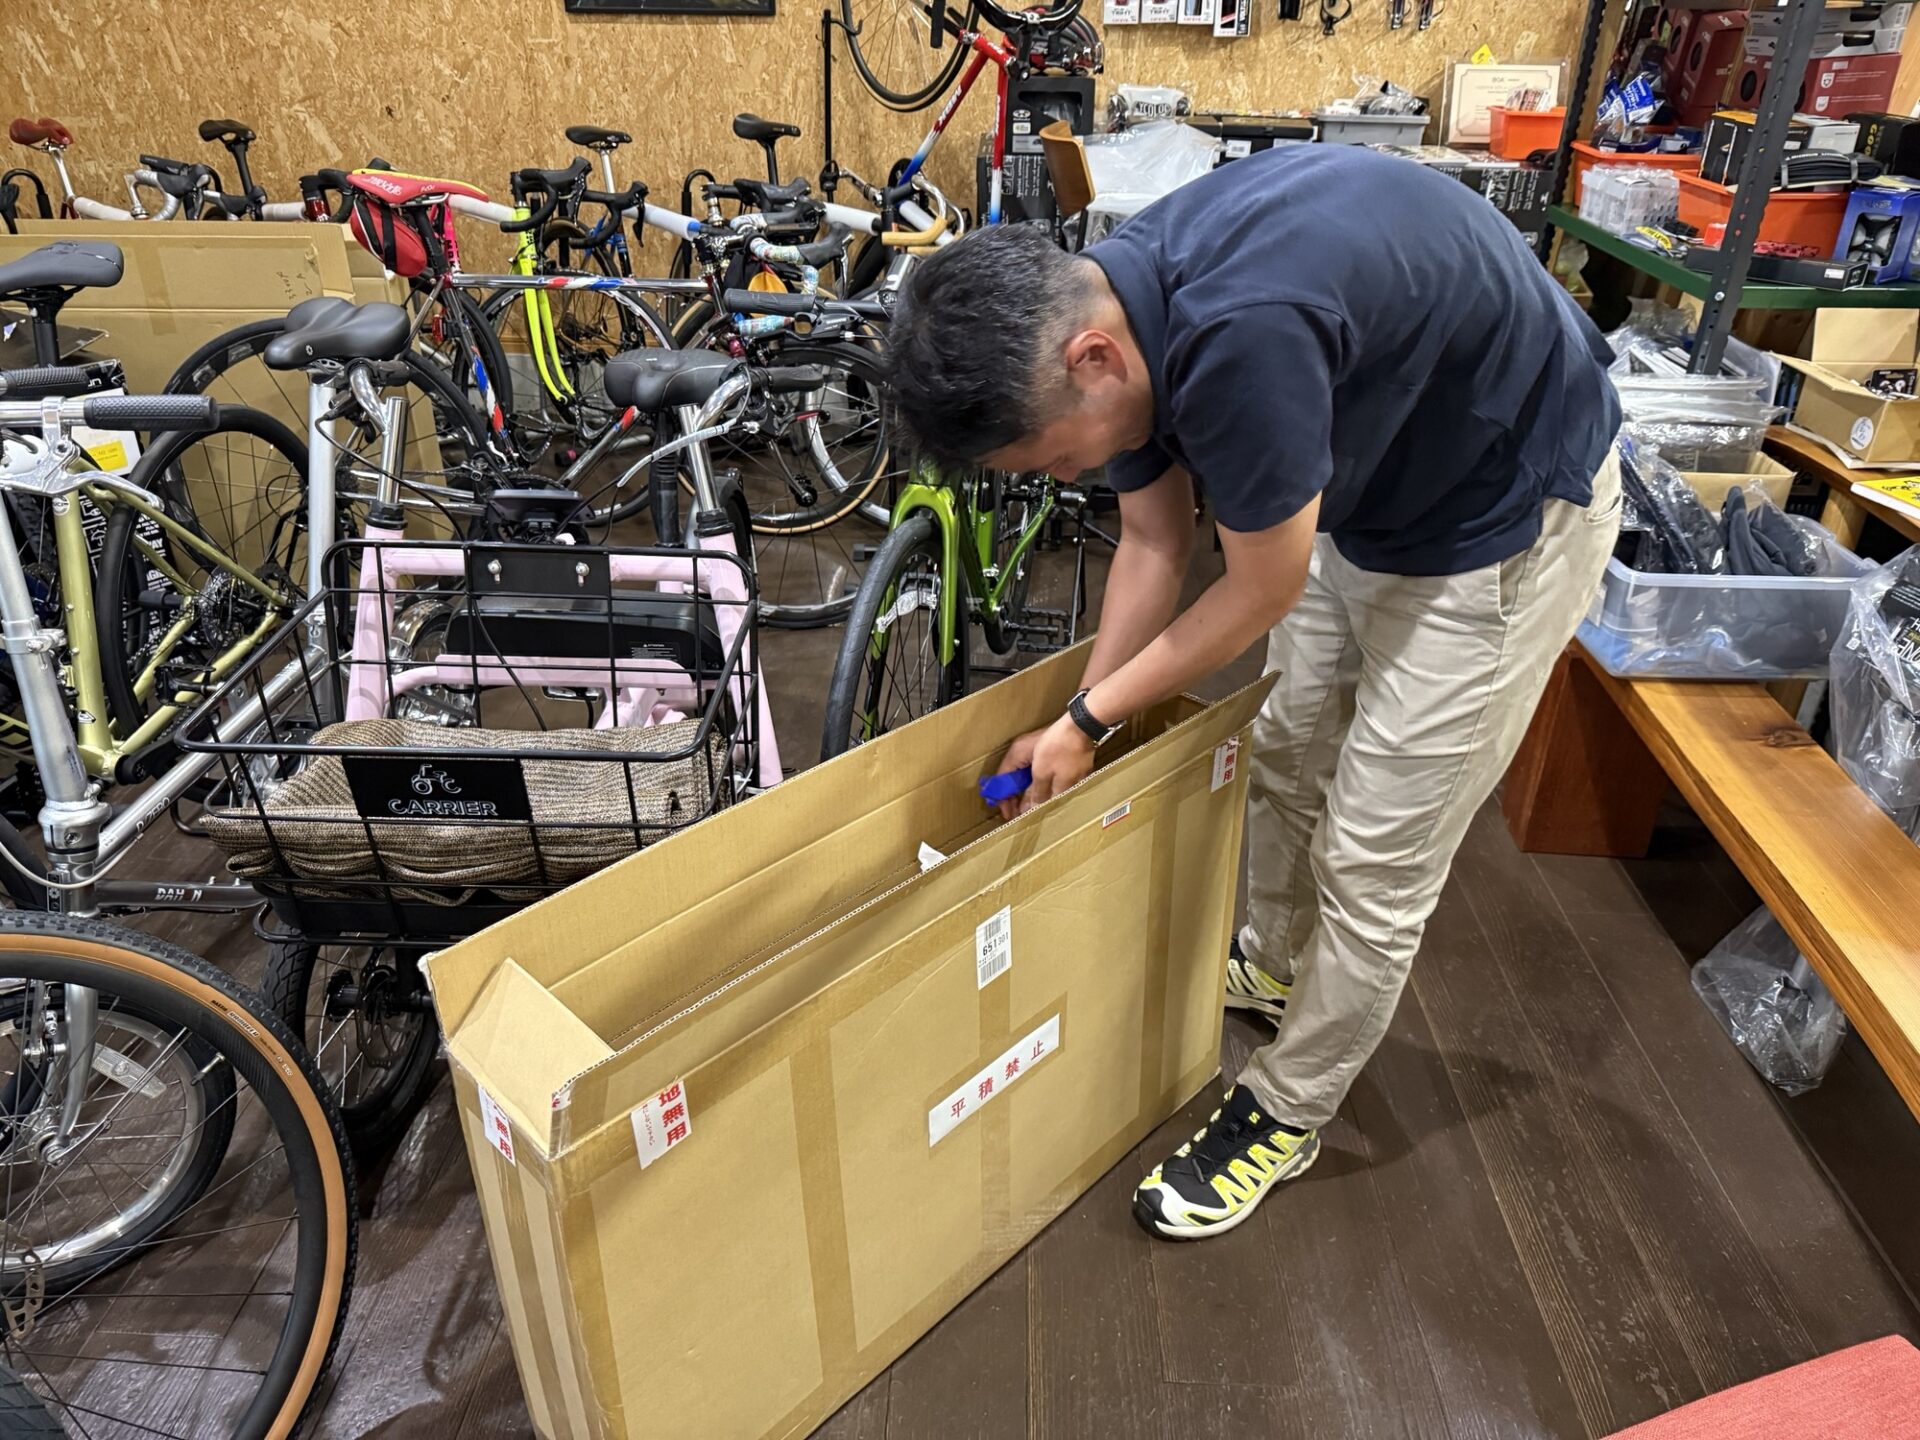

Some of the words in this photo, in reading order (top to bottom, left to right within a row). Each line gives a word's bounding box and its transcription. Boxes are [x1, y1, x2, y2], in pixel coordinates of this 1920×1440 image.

[388, 798, 499, 817] CARRIER
[154, 886, 204, 902] DAHN
[950, 1039, 1046, 1119] 平積禁止
